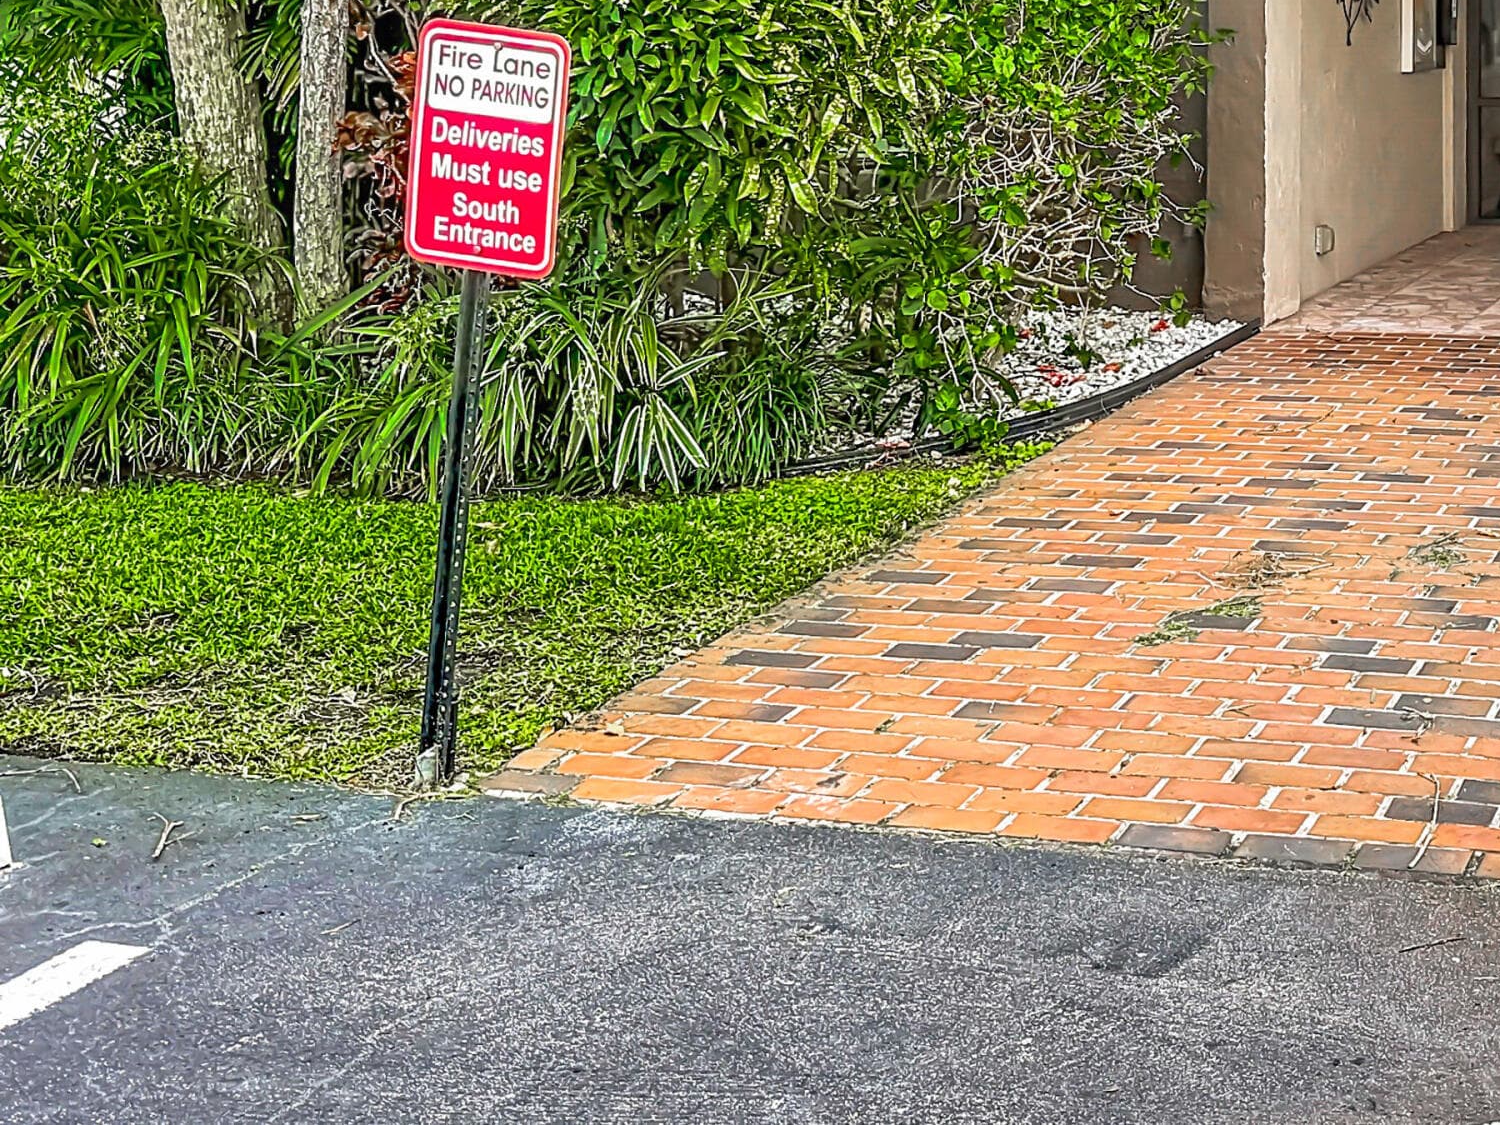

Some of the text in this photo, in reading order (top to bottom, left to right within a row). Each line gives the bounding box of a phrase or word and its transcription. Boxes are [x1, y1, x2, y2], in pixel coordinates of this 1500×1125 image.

[438, 43, 551, 80] Fire Lane
[434, 73, 549, 109] NO PARKING
[430, 116, 545, 157] Deliveries
[431, 152, 543, 193] Must use
[452, 192, 520, 224] South
[433, 216, 537, 254] Entrance
